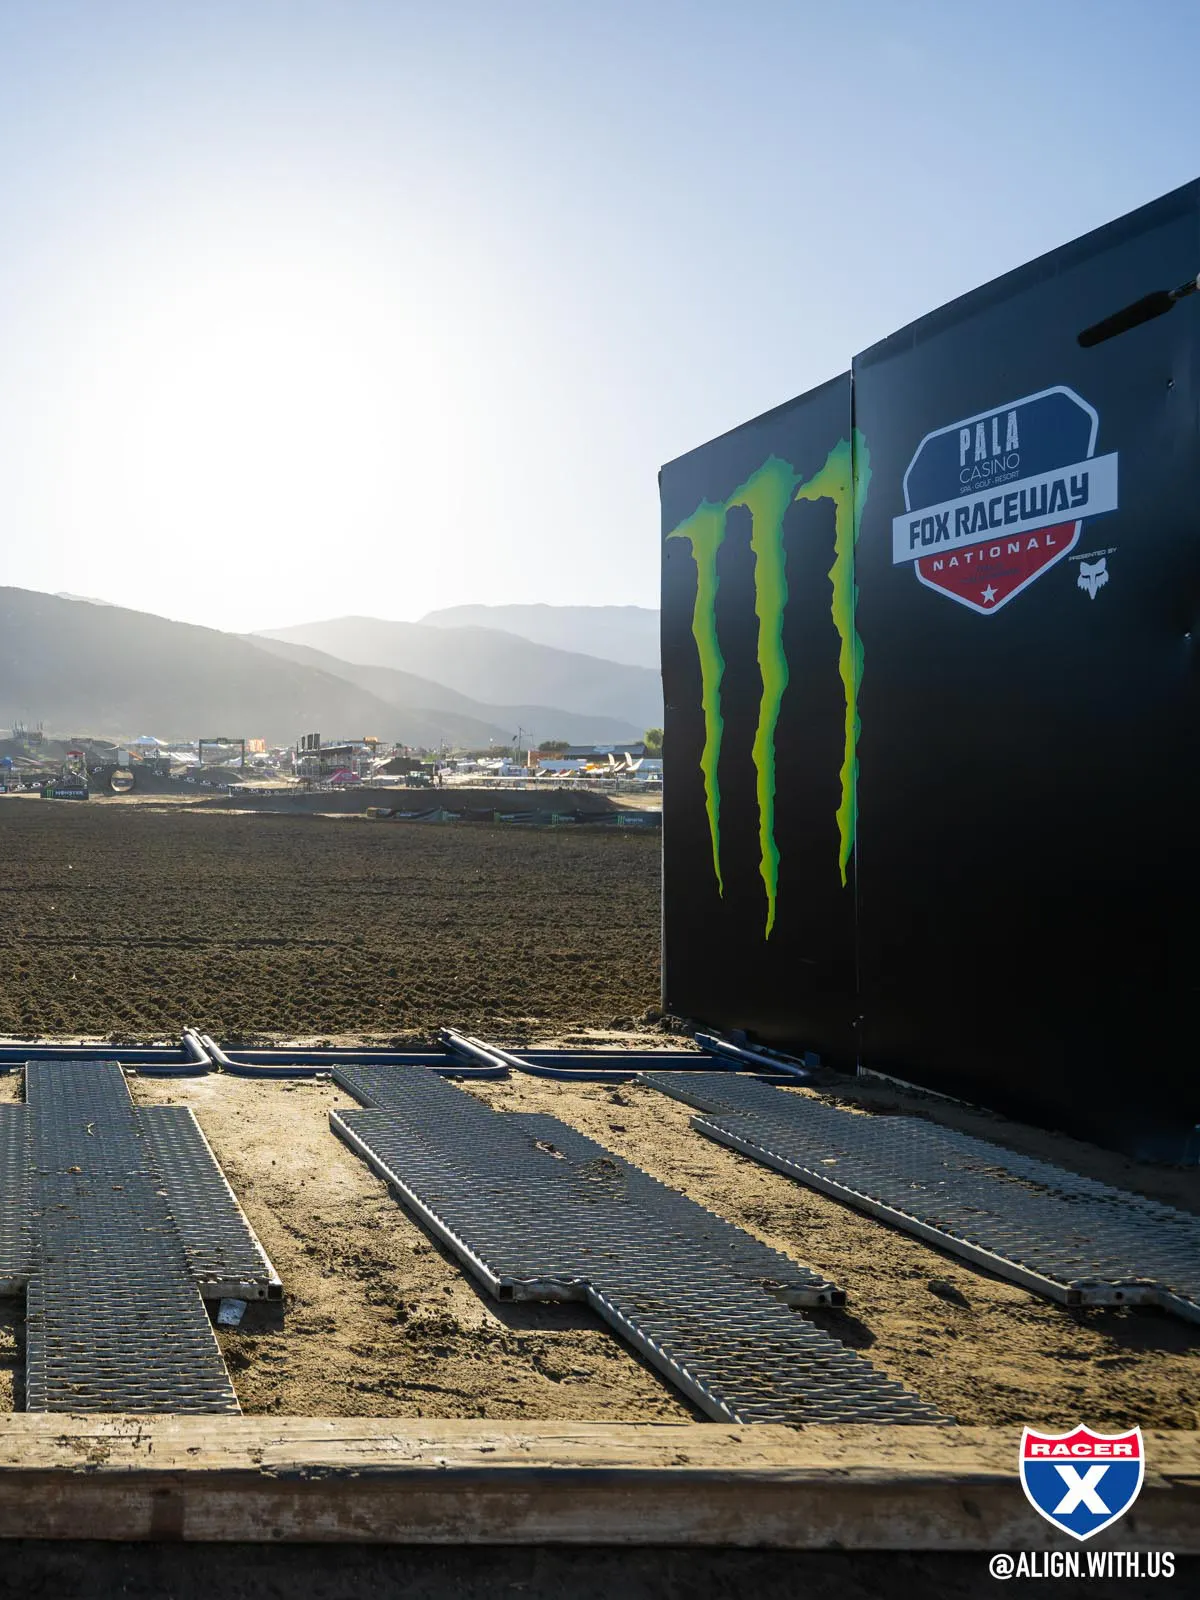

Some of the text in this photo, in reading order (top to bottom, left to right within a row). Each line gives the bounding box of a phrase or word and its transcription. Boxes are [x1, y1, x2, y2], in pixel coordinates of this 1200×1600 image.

[960, 410, 1019, 466] PALA
[959, 453, 1020, 483] CASINO
[959, 470, 1020, 494] SPA GOLF RESORT
[909, 472, 1089, 550] FOX RACEWAY
[933, 535, 1056, 571] NATIONAL
[1068, 549, 1106, 561] PRESENTED
